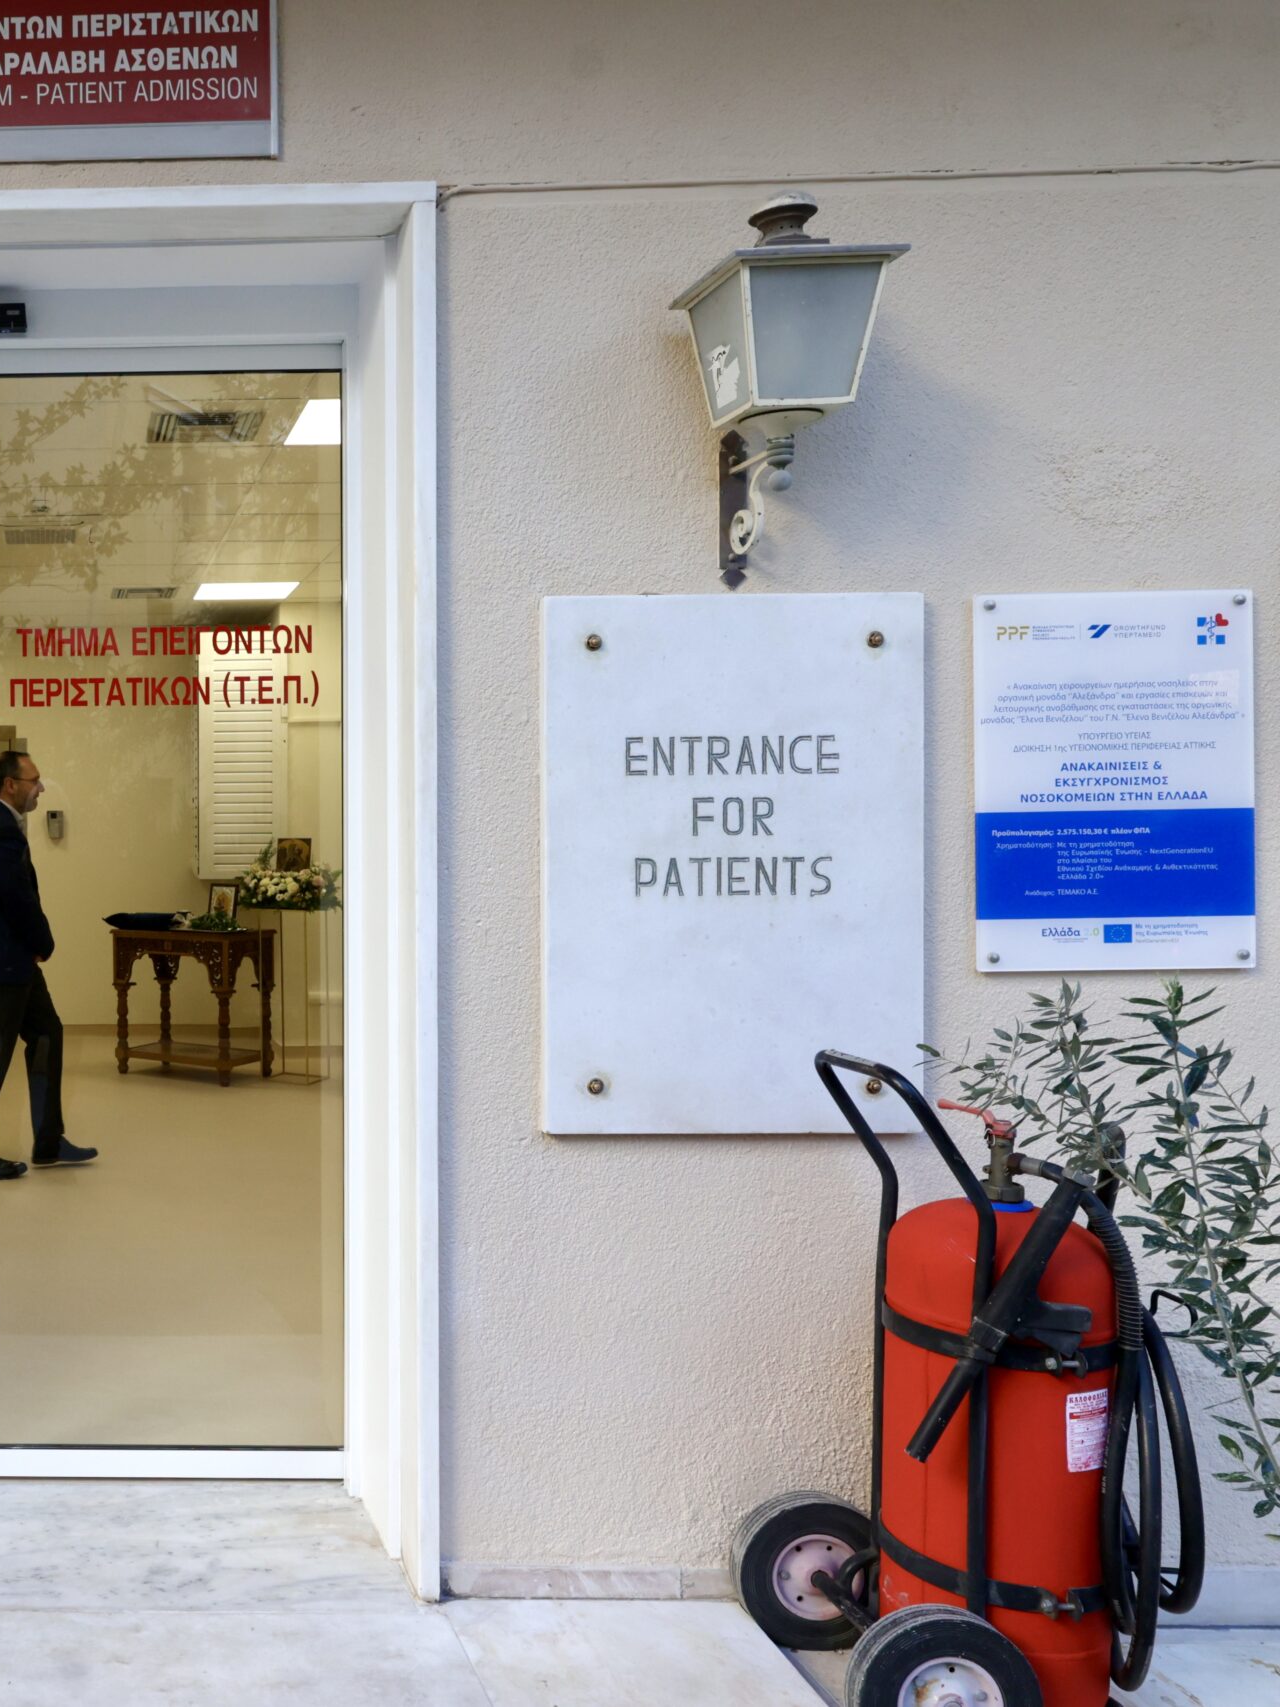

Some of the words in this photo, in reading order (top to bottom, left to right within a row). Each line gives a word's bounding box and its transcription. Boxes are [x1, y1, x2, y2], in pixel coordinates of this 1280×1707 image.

[72, 9, 258, 38] ΠΕΡΙΣΤΑΤΙΚΩΝ
[114, 45, 238, 72] ΑΣΘΕΝΩΝ
[36, 81, 127, 105] PATIENT
[134, 76, 258, 102] ADMISSION
[16, 627, 119, 657] ΤΜΗΜΑ
[131, 624, 313, 656] ΕΠΕΙΓΟΝΤΩΝ
[997, 625, 1030, 640] PPF
[10, 676, 210, 708] ΠΕΡΙΣΤΑΤΙΚΩΝ
[223, 670, 319, 708] (Τ.Ε.Π.)
[1013, 744, 1051, 753] ΔΙΟΙΚΗΣΗ
[1068, 742, 1128, 752] ΥΓΕΙΟΝΟΜΙΚΗΣ
[1131, 741, 1181, 751] ΠΕΡΙΦΕΡΕΙΑΣ
[1183, 740, 1216, 750] ΑΤΤΙΚΗΣ
[1078, 732, 1123, 741] ΥΠΟΥΡΓΕΙΟ
[1125, 731, 1151, 740] ΥΓΕΙΑΣ
[624, 734, 840, 777] ENTRANCE
[1060, 761, 1148, 772] ΑΝΑΚΑΙΝΙΣΕΙΣ
[1153, 761, 1162, 770] &
[1055, 776, 1169, 788] ΕΚΣΥΓΧΡΟΝΙΣΜΟΣ
[1020, 792, 1115, 804] ΝΟΣΟΚΟΜΕΙΩΝ
[1120, 791, 1152, 802] ΣΤΗΝ
[1157, 790, 1208, 801] ΕΛΛΑΔΑ
[691, 796, 774, 837] FOR
[633, 856, 833, 897] PATIENTS
[1041, 927, 1080, 937] Ελλάδα
